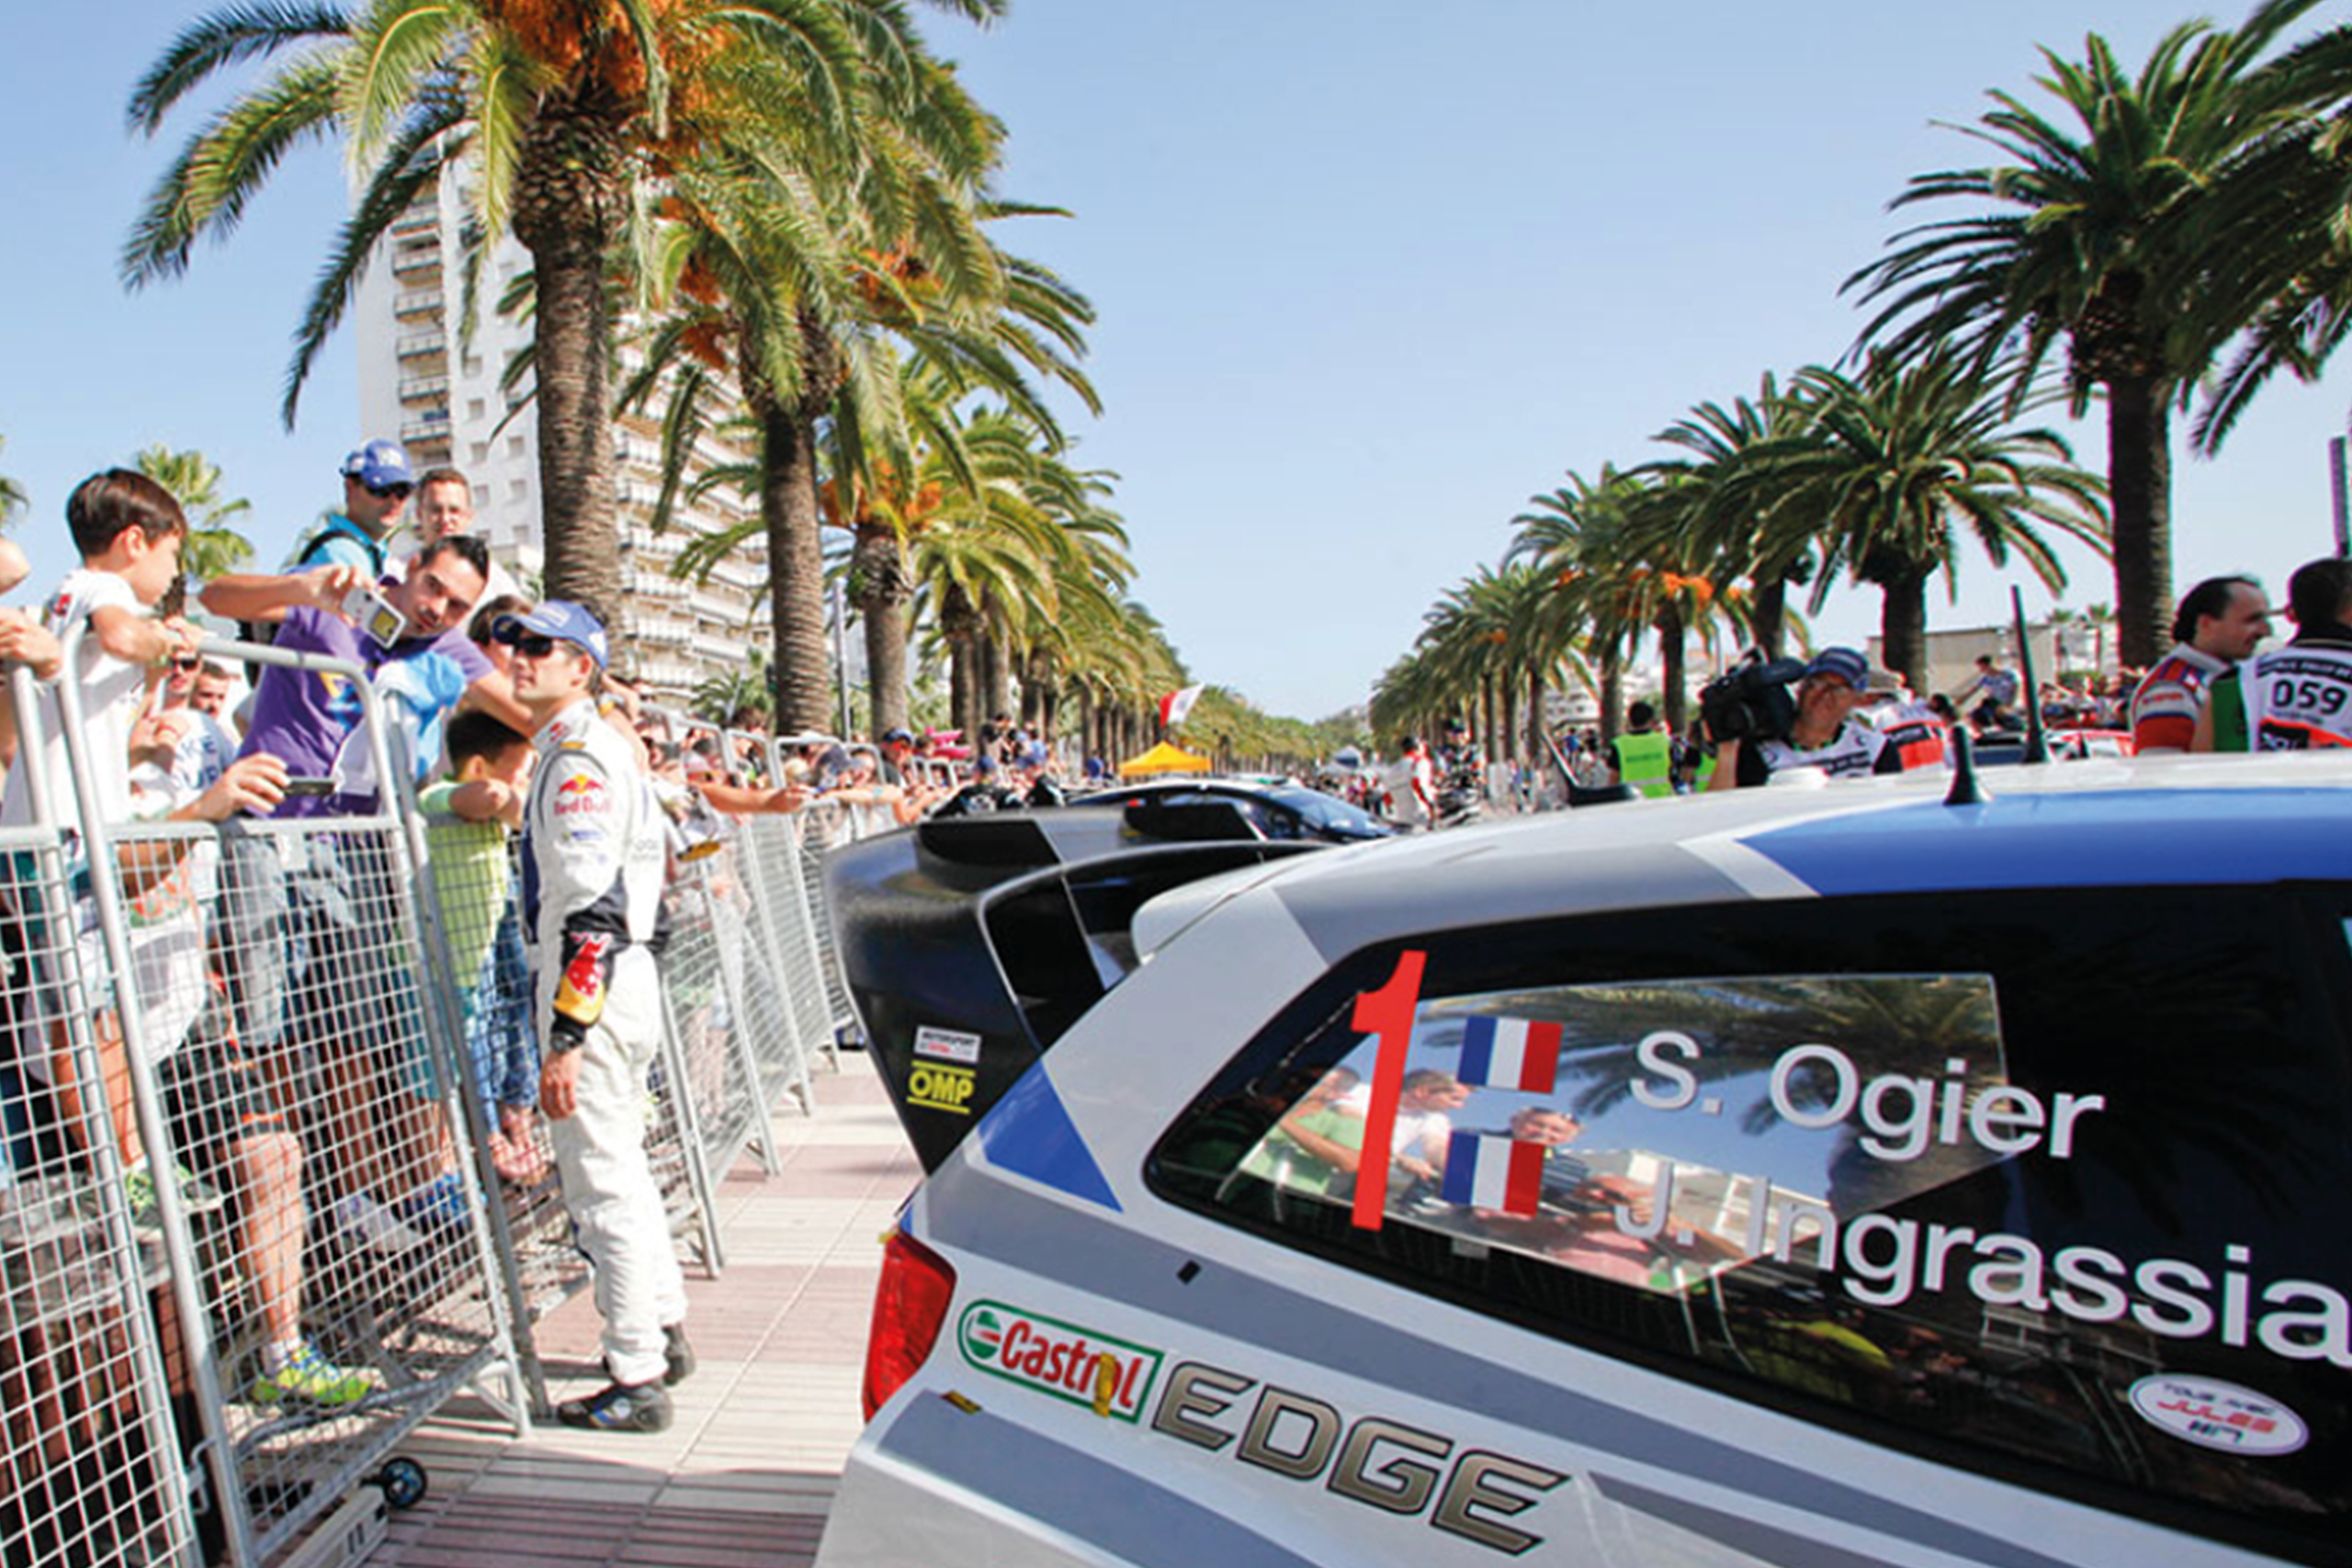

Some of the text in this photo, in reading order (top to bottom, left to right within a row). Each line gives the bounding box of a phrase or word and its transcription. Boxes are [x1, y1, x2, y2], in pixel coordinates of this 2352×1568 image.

[2273, 680, 2347, 715] 059
[909, 1068, 975, 1105] OMP
[1351, 950, 1427, 1231] 1
[1630, 1031, 2105, 1161] S. Ogier
[1614, 1161, 2352, 1369] J. Ingrassia
[1151, 1360, 1572, 1557] EDGE
